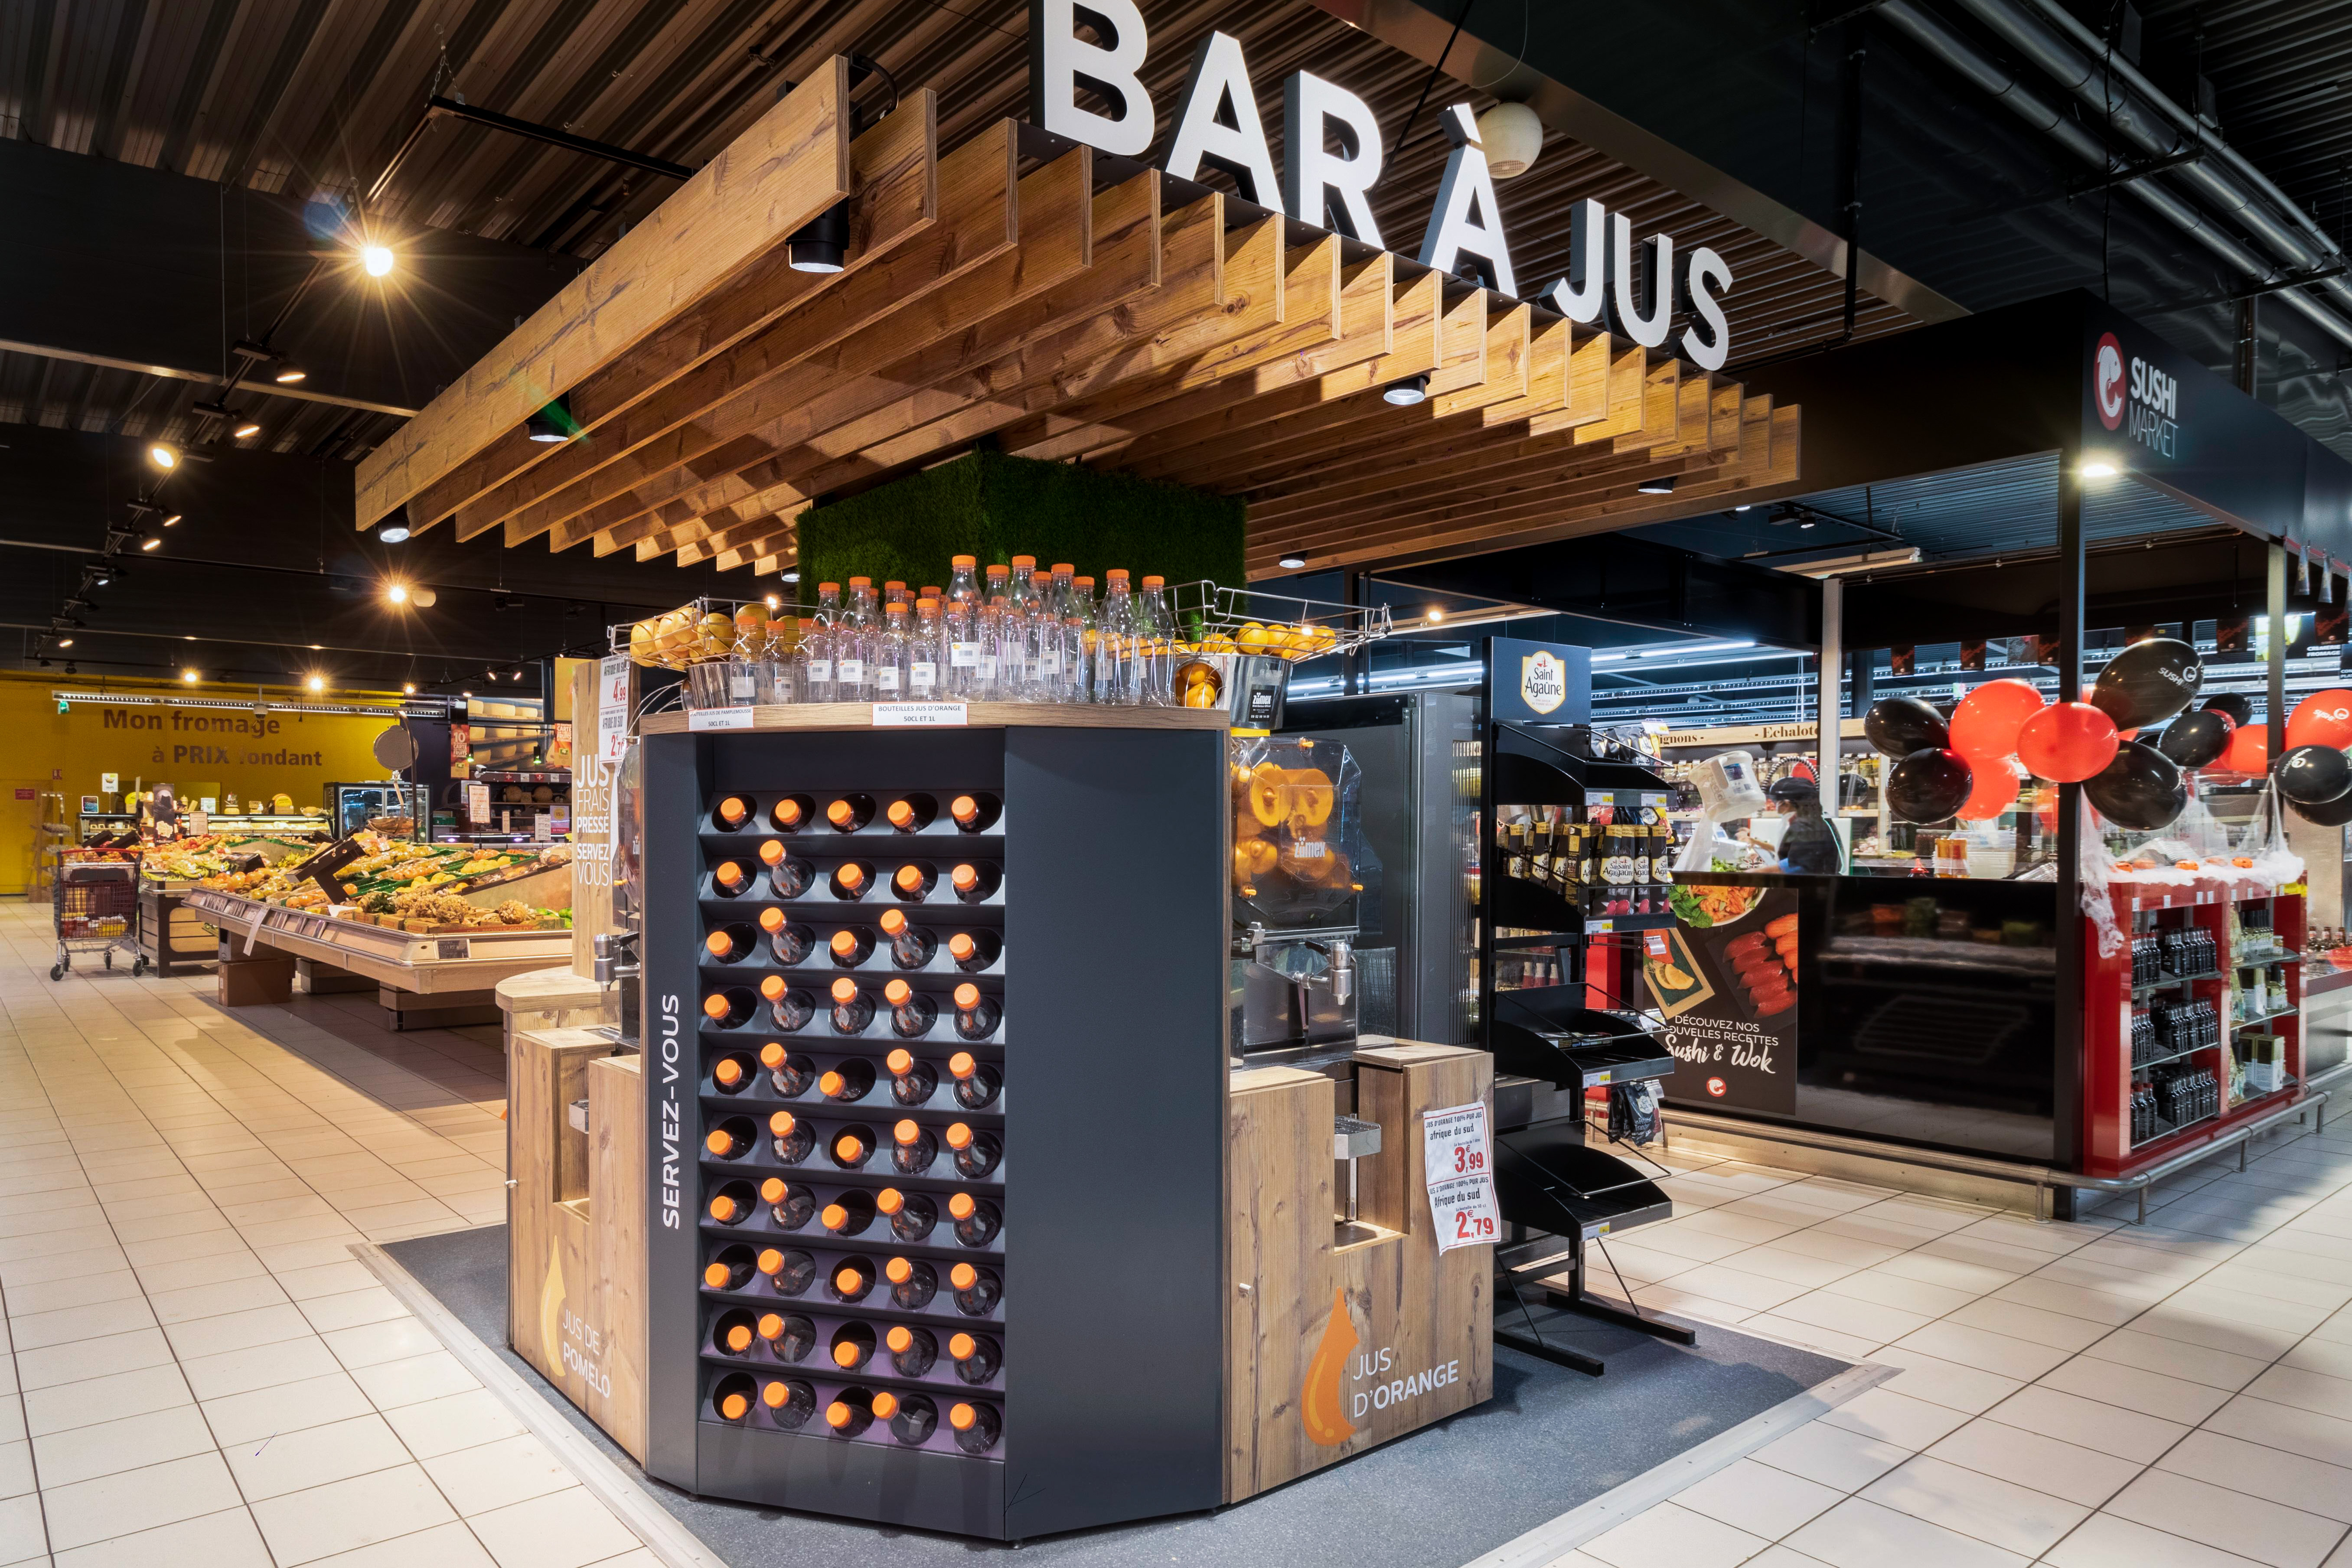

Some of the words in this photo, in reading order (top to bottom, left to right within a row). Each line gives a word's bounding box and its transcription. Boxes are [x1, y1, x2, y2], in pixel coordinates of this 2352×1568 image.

[1030, 0, 1386, 251] BAR
[1420, 103, 1517, 299] À
[1539, 199, 1733, 371] JUS
[2130, 357, 2176, 420] SUSHI
[2129, 401, 2179, 460] MARKET
[1534, 667, 1553, 681] Saint
[2158, 667, 2184, 685] SUSHI
[1525, 676, 1562, 698] Agaûne
[104, 709, 162, 729] Mon
[171, 711, 280, 738] fromage
[1658, 734, 1697, 745] ignons
[152, 747, 164, 763] à
[174, 745, 230, 764] PRIX
[577, 754, 609, 788] JUS
[577, 787, 609, 812] FRAIS
[577, 812, 609, 833] PRÉSSÉ
[577, 843, 609, 861] SERVEZ
[577, 861, 609, 887] VOUS
[1675, 1014, 1733, 1030] DÉCOUVEZ
[1736, 1022, 1759, 1033] NOS
[1724, 1031, 1778, 1046] RECETTES
[1665, 1033, 1710, 1064] Sushi
[1731, 1037, 1776, 1074] Wok
[662, 994, 679, 1230] SERVEZ-VOUS
[1430, 1129, 1452, 1140] afrique
[1454, 1126, 1461, 1135] du
[1463, 1123, 1474, 1134] sud
[1435, 1195, 1455, 1209] Afrique
[1457, 1191, 1465, 1202] du
[1467, 1188, 1480, 1200] sud
[563, 1309, 582, 1340] JUS
[585, 1324, 600, 1356] DE
[563, 1340, 610, 1399] POMELO
[1353, 1346, 1391, 1380] JUS
[1354, 1359, 1459, 1418] D'ORANGE
